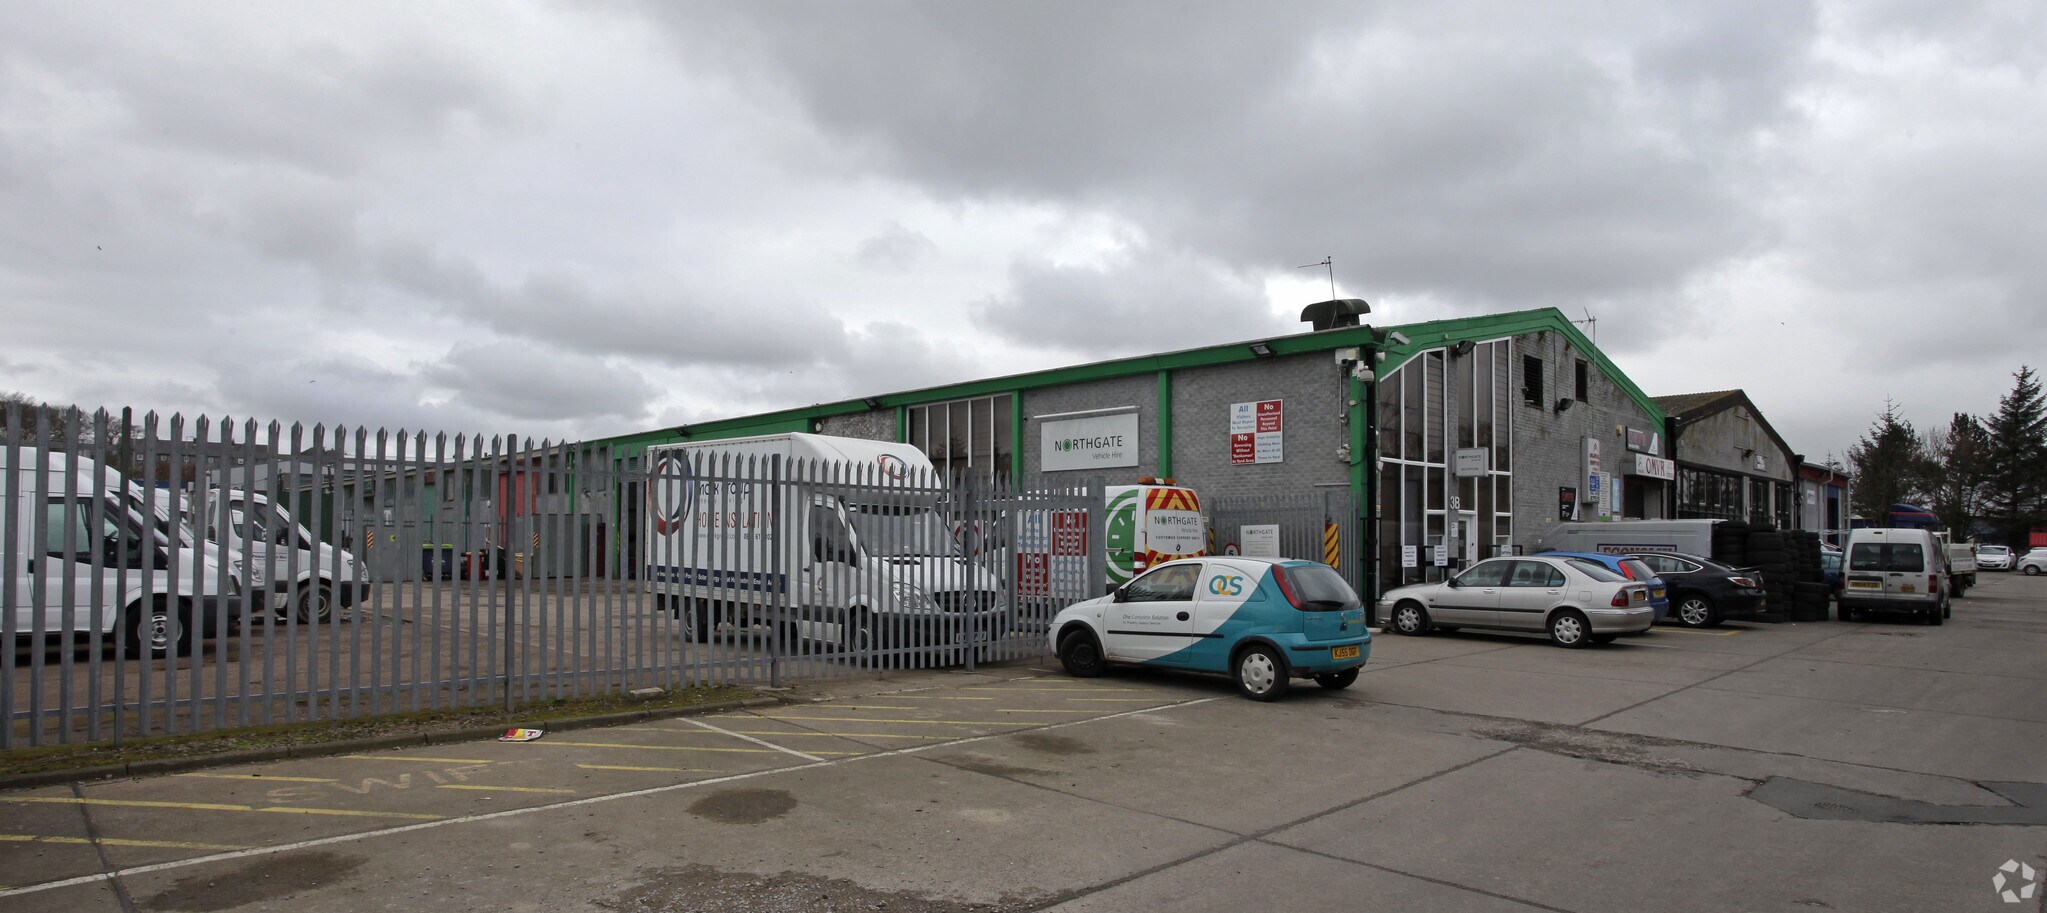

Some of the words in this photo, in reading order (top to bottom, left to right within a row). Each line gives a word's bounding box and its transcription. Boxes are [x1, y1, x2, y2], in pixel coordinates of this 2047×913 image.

[1239, 405, 1248, 413] All
[1055, 436, 1122, 452] NORTHGATE
[1646, 458, 1665, 477] OMVR
[1450, 496, 1460, 509] 3B
[1154, 516, 1198, 525] NORTHGATE
[1209, 575, 1243, 596] OCS
